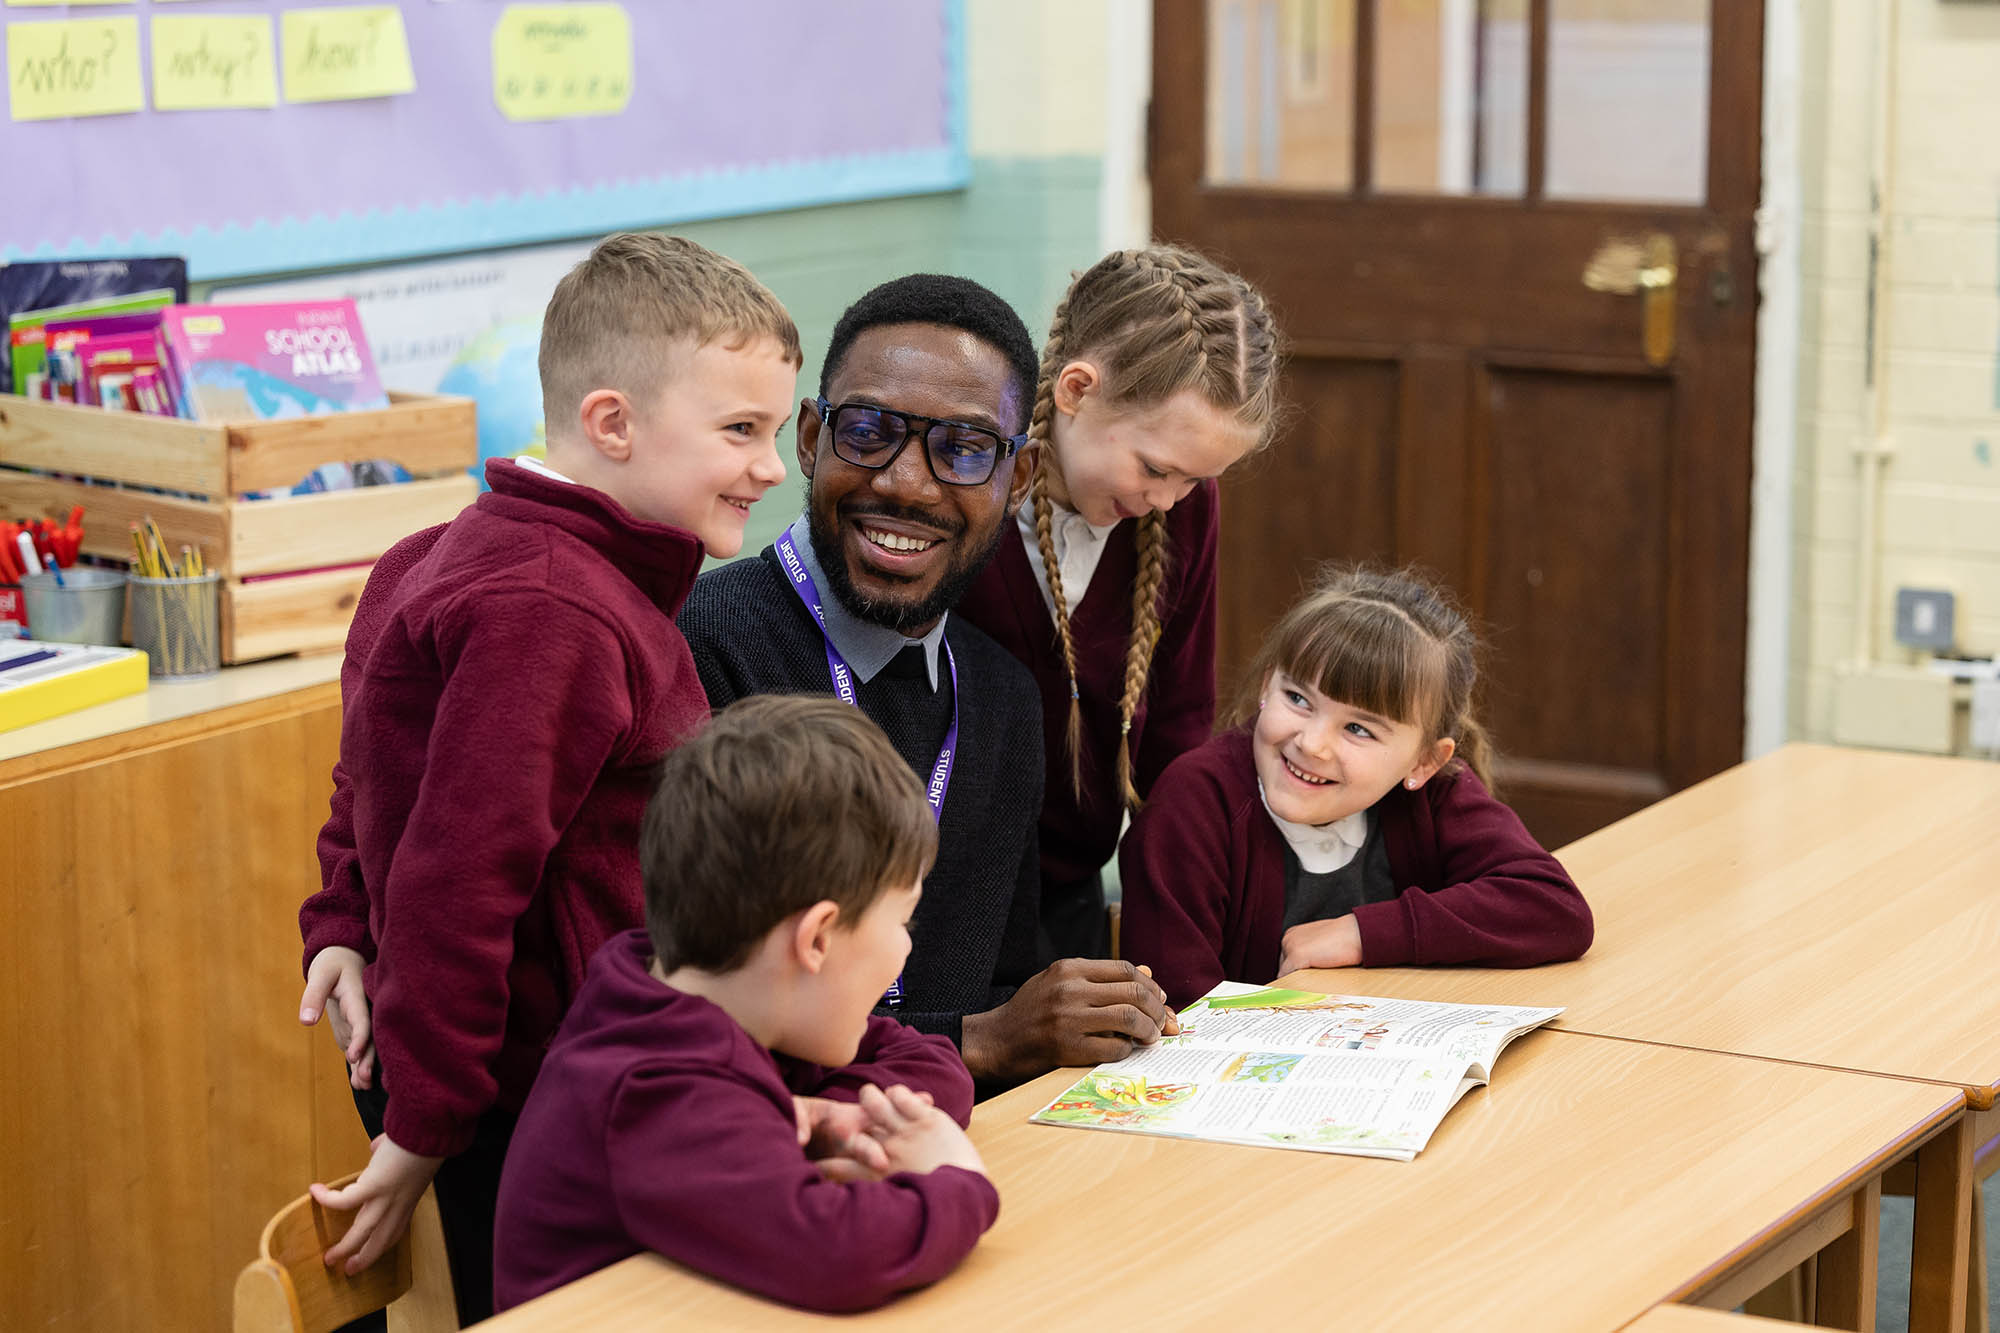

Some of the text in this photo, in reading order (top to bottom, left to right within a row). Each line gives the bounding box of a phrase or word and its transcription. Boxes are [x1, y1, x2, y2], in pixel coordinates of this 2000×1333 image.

[18, 28, 118, 92] who?
[265, 326, 354, 355] SCHOOL
[292, 345, 362, 377] ATLAS
[780, 540, 807, 584] STUDENT
[834, 663, 854, 705] UDENT
[928, 749, 951, 808] STUDENT
